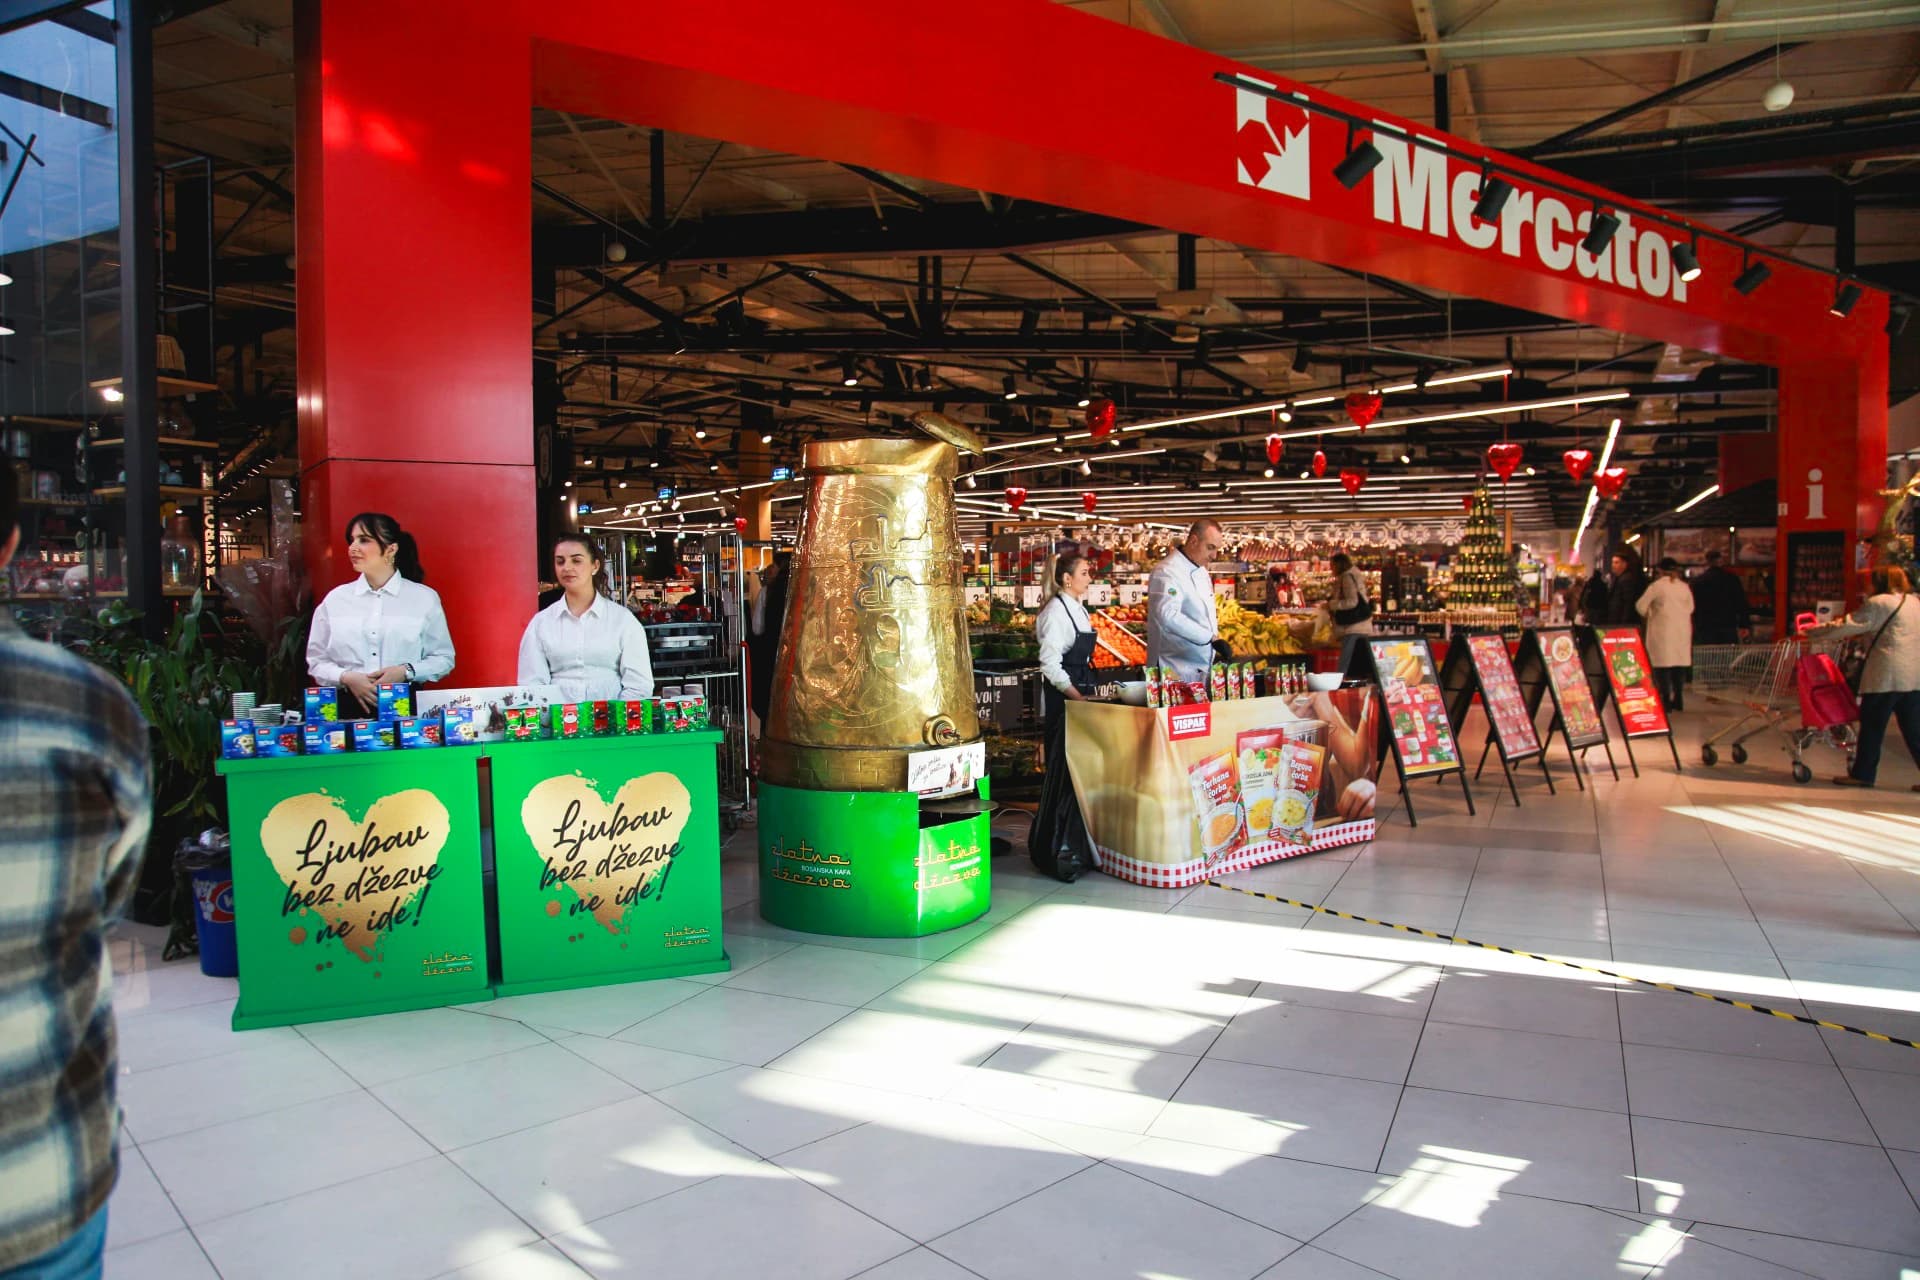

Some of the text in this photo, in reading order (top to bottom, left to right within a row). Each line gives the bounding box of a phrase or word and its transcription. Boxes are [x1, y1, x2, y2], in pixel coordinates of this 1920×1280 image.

[1172, 717, 1207, 731] VISPAK
[1201, 771, 1230, 791] Tarhana
[296, 819, 429, 885] Ljubav
[552, 799, 673, 862] Ljubav
[771, 836, 851, 866] zlatna
[913, 839, 981, 867] zlatna
[281, 863, 444, 917] bez džezve
[539, 842, 685, 891] bez džezve
[569, 860, 674, 917] ne ide!
[801, 865, 852, 876] BOSANSKA KAFA
[316, 883, 432, 944] ne ide!
